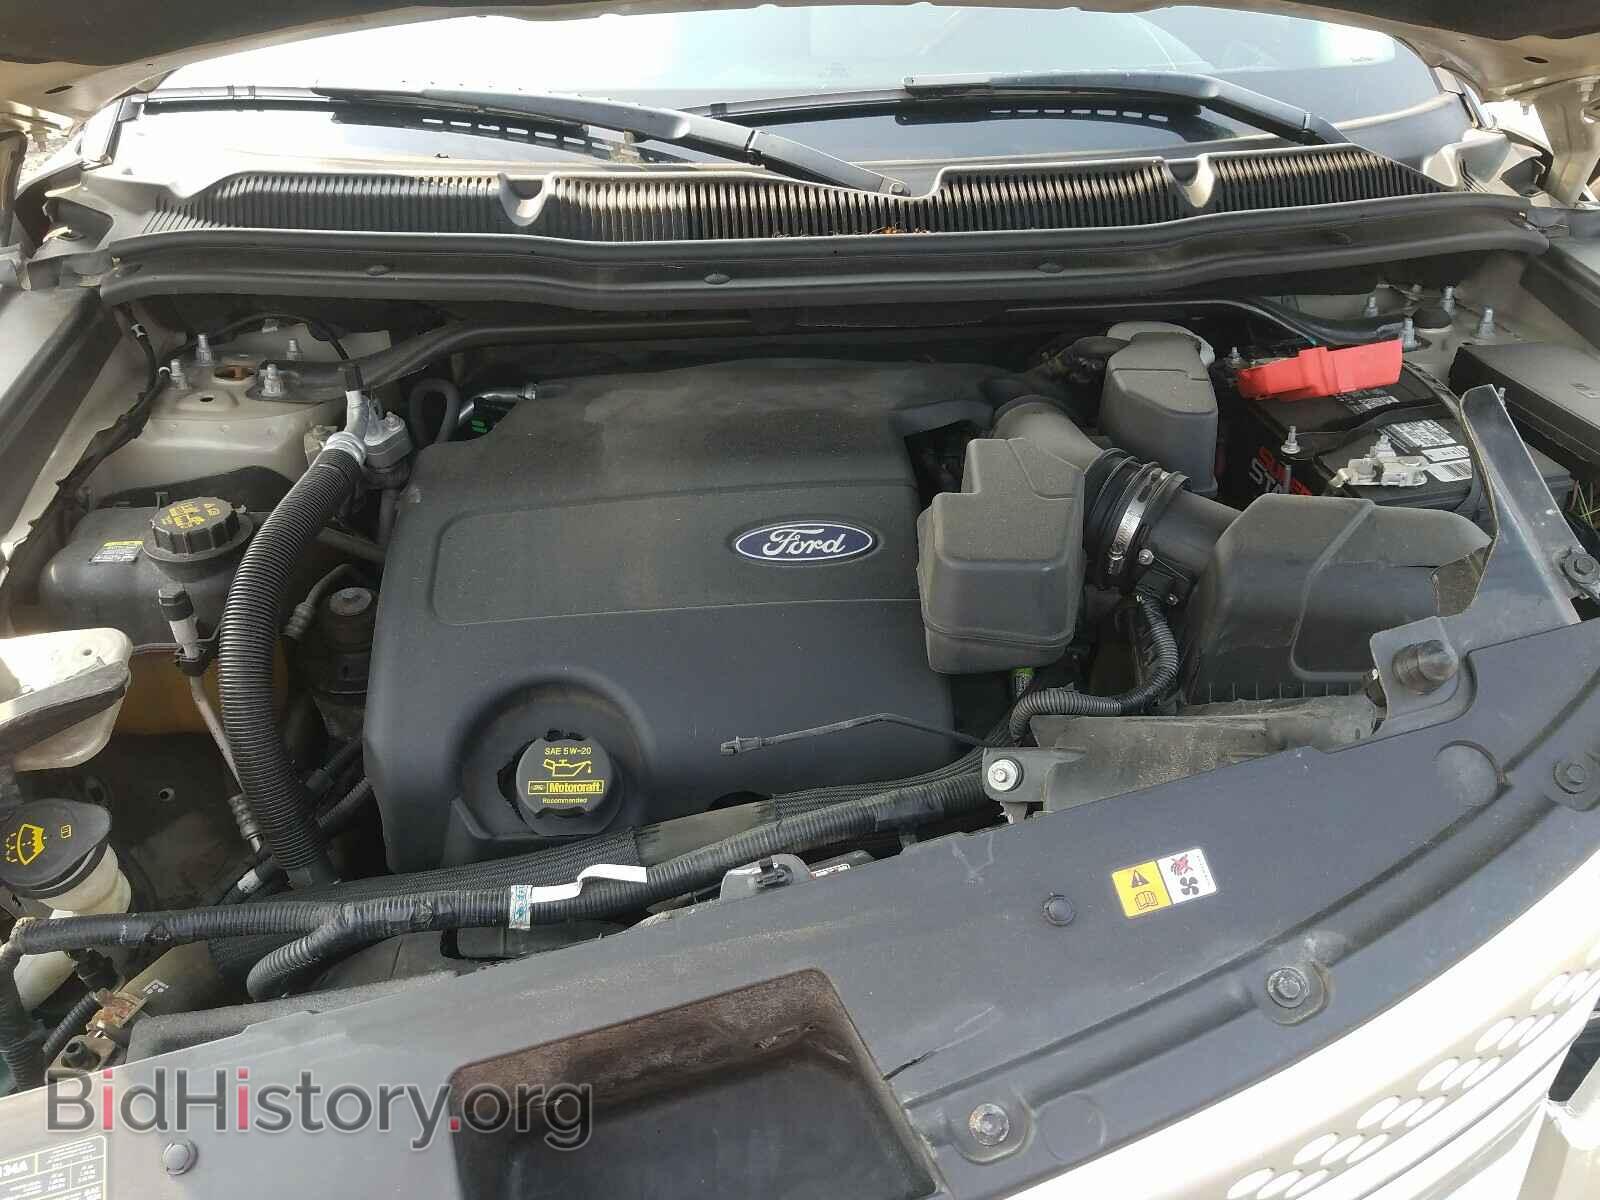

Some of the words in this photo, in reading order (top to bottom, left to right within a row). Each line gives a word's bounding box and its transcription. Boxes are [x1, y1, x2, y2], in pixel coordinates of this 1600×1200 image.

[762, 528, 846, 556] Ford
[544, 747, 562, 755] SAE
[563, 747, 592, 755] 5W-20
[549, 781, 601, 793] Motorcraft
